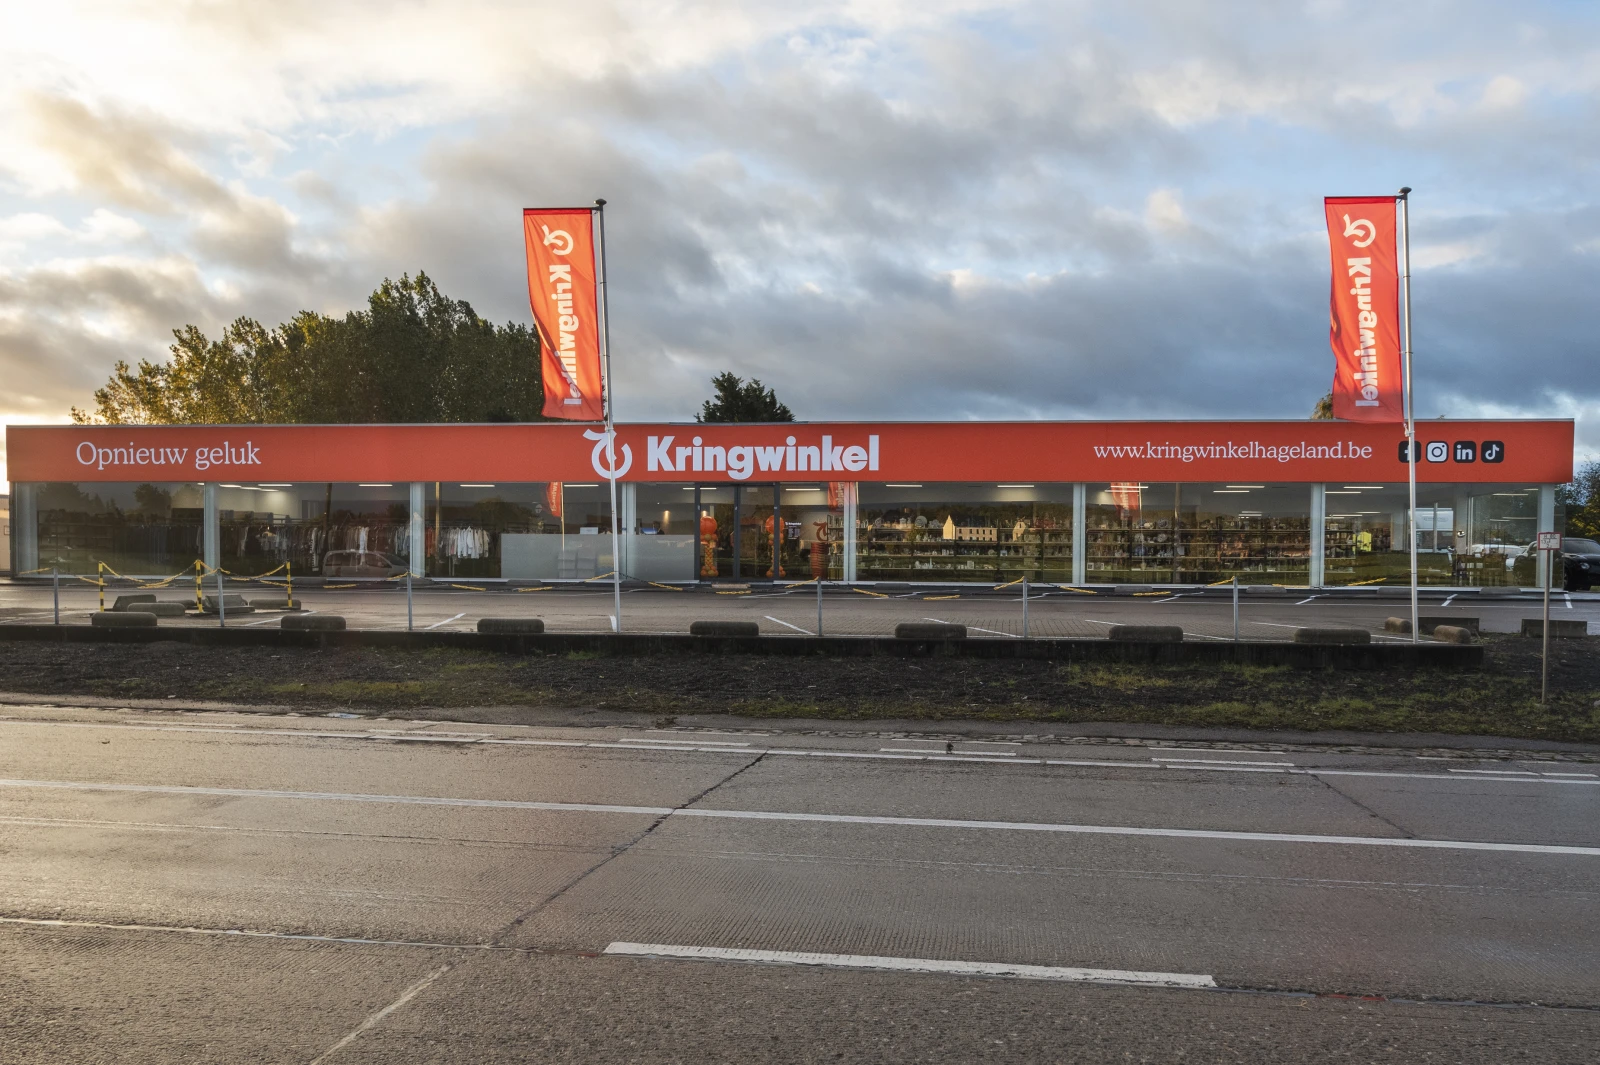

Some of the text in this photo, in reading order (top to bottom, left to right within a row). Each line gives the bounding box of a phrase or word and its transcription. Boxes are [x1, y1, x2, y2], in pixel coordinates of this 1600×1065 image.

[76, 441, 262, 470] Opnieuw geluk
[647, 434, 880, 480] Kringwinkel
[1093, 440, 1373, 463] www.kringwinkelhageland.be
[1456, 444, 1473, 460] in
